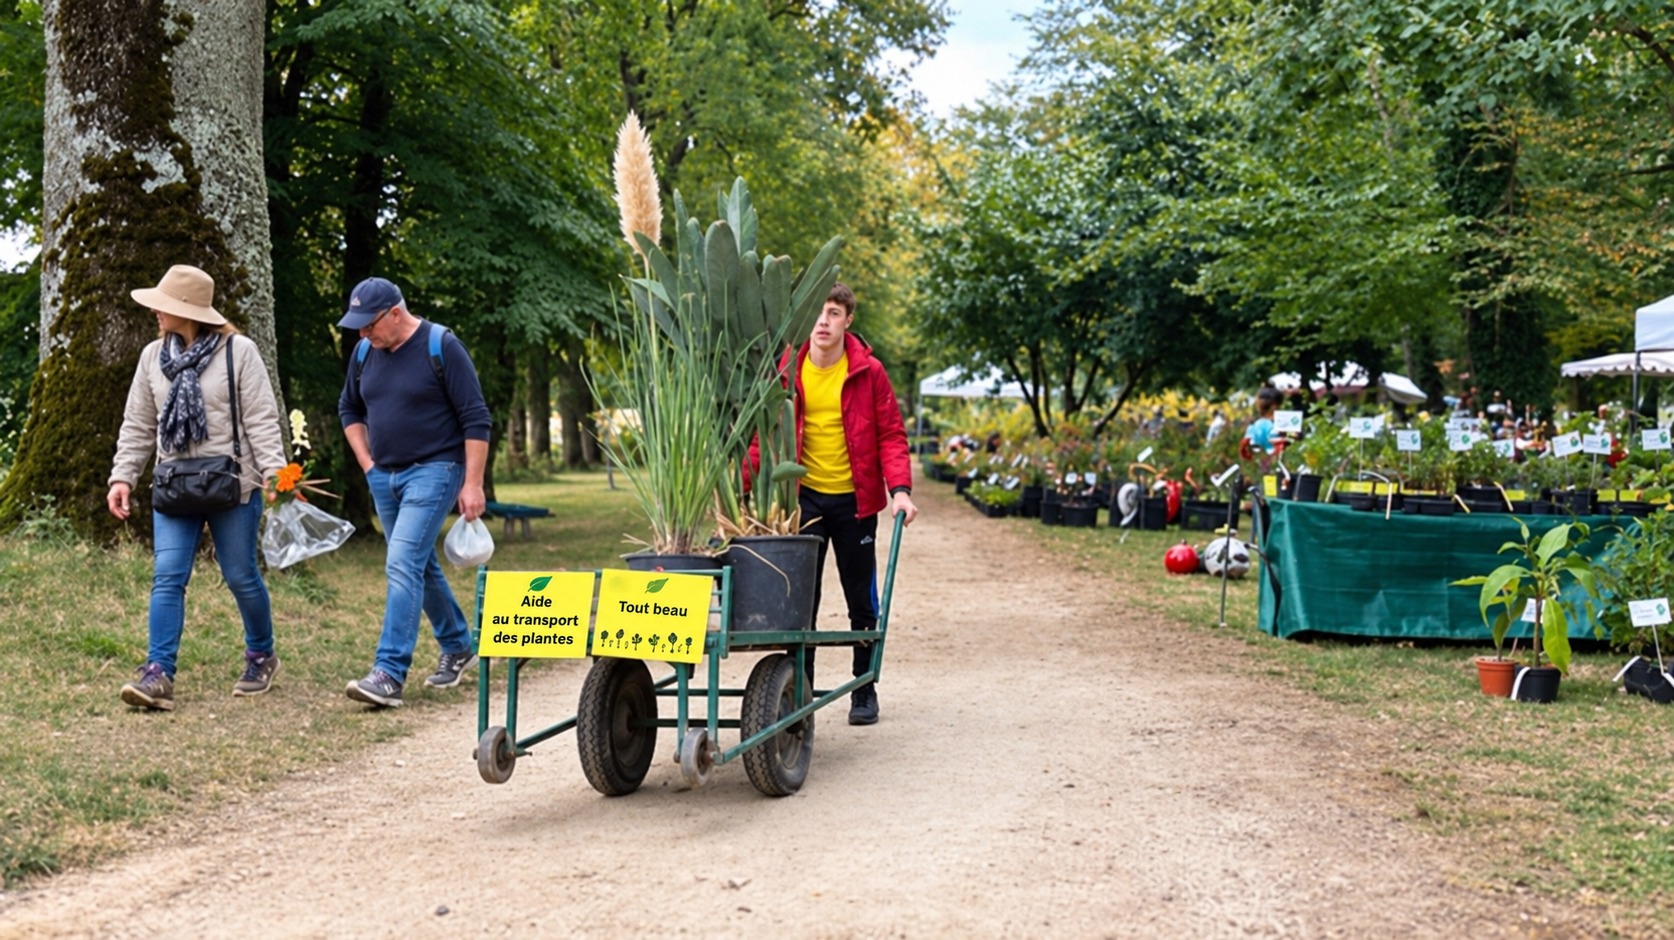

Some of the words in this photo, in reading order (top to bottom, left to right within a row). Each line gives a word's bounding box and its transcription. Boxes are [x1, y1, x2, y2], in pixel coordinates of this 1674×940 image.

[521, 595, 552, 608] Aide
[619, 600, 650, 615] Tout
[653, 602, 688, 617] beau
[492, 614, 510, 625] au
[513, 613, 579, 629] transport
[493, 631, 517, 643] des
[521, 632, 574, 646] plantes
